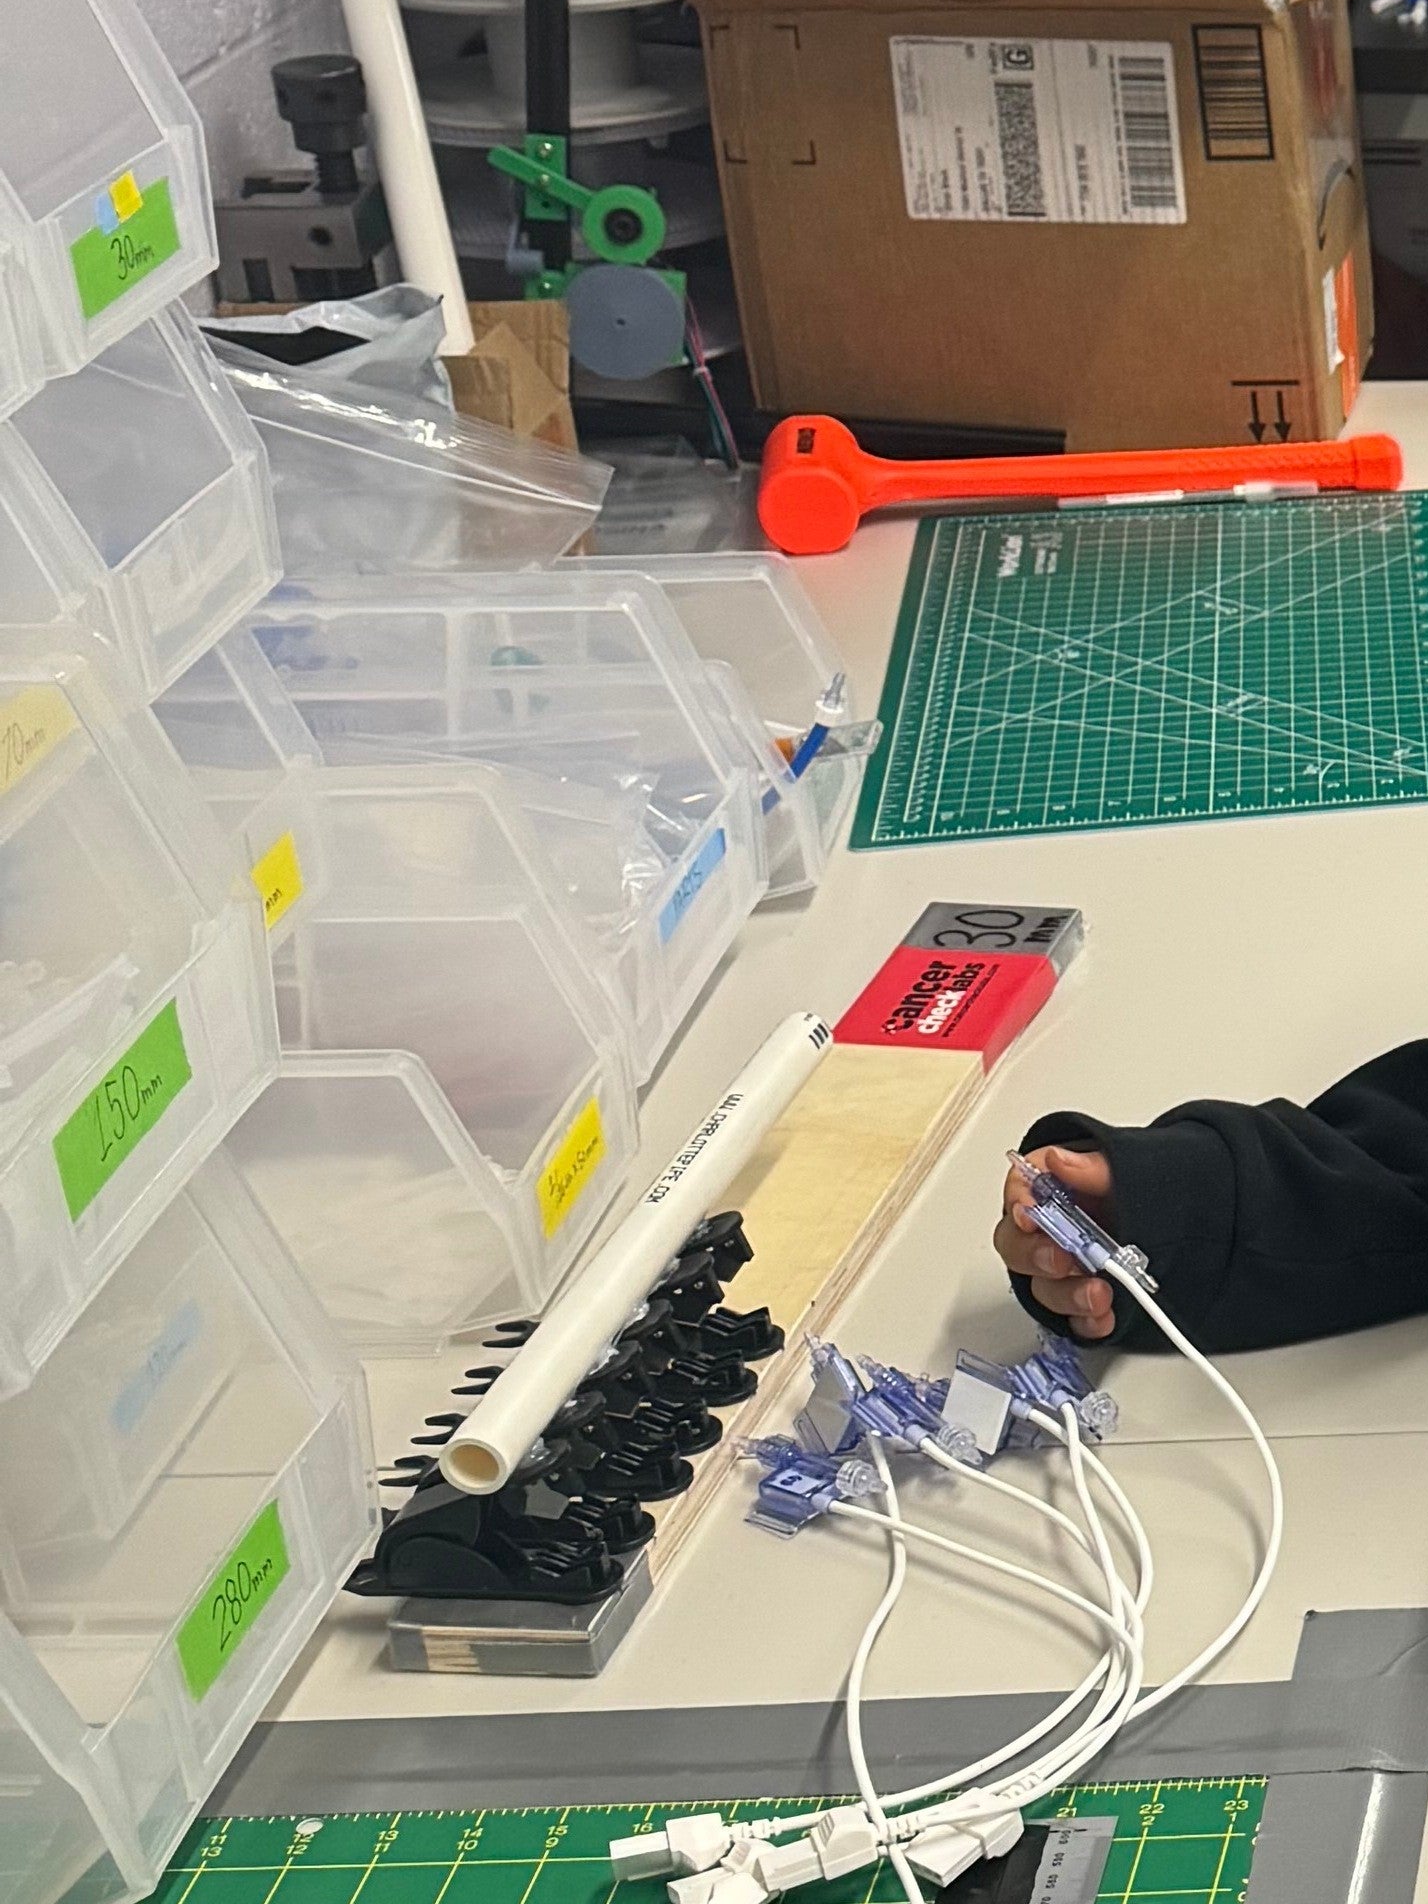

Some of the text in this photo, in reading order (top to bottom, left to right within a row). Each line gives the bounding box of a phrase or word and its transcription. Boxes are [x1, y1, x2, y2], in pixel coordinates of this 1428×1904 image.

[111, 235, 154, 280] 30mm
[933, 909, 1024, 948] 30
[96, 1065, 163, 1162] 150mm
[212, 1558, 272, 1652] 280mm
[1056, 1800, 1249, 1818] 21 22 23
[1141, 1814, 1156, 1826] 2
[201, 1837, 559, 1858] 13 12 11 10 9
[210, 1834, 228, 1845] 11
[378, 1830, 399, 1841] 13
[462, 1828, 484, 1839] 14
[548, 1825, 568, 1837] 15
[631, 1822, 654, 1834] 16
